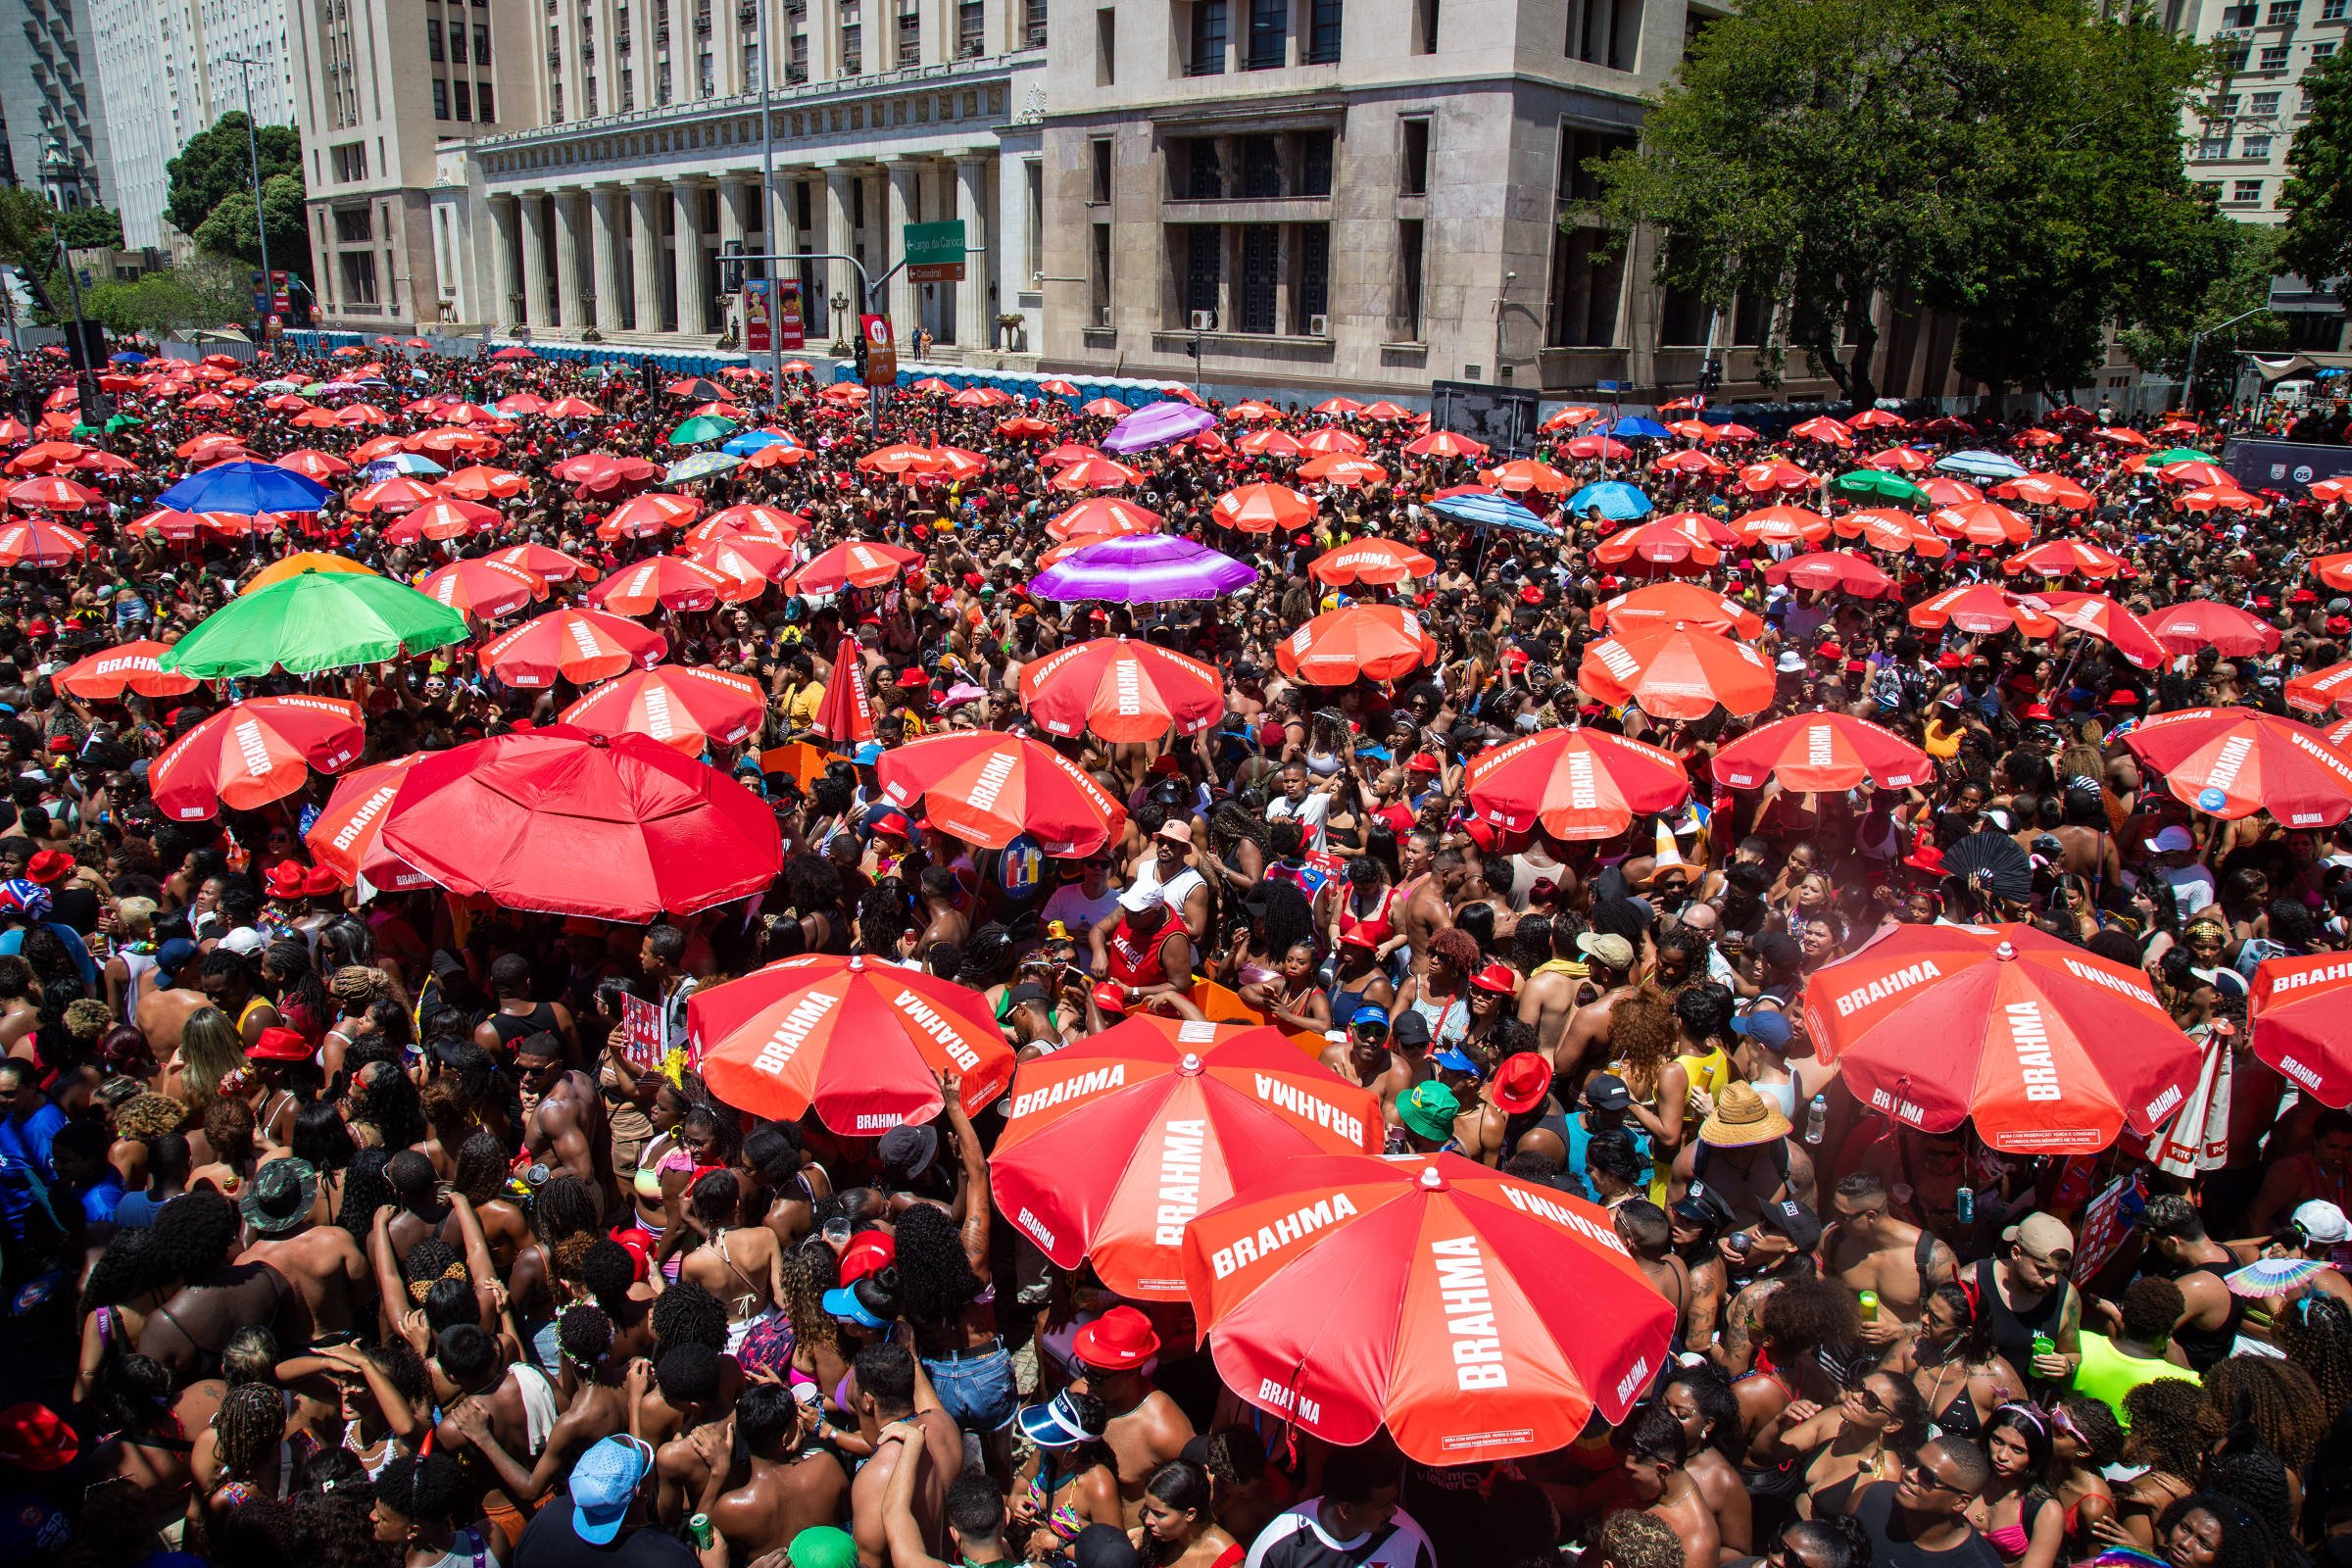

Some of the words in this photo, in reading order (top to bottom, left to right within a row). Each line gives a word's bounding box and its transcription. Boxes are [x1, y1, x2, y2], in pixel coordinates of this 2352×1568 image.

[941, 236, 964, 249] Carioca
[916, 268, 942, 278] Catedral
[890, 452, 932, 462] BRAHMA
[1744, 520, 1790, 533] BRAHMA
[1336, 552, 1391, 567] BRAHMA
[494, 602, 516, 615] BRAHMA
[568, 620, 601, 659] BRAHMA
[95, 656, 177, 675] BRAHM
[1033, 645, 1089, 688] BRAHMA
[1116, 659, 1141, 715] BRAHMA
[645, 686, 672, 739] BRAHMA
[727, 725, 749, 742] BRAHMA
[234, 718, 272, 777] BRAHMA
[1474, 739, 1538, 778] BRAHMA
[1809, 725, 1832, 765] BRAHMA
[2206, 735, 2254, 790] BRAHMA
[887, 781, 908, 801] BRAHMA
[966, 752, 1018, 812] BRAHMA
[1054, 755, 1112, 816] BRAHMA
[1568, 751, 1596, 809] BRAHMA
[180, 807, 205, 817] BRAHMA
[332, 786, 398, 852] BRAHMA
[1490, 810, 1515, 827] BRAMA
[2292, 812, 2324, 824] BRAHMA
[1044, 842, 1075, 854] BRAHMA
[1836, 960, 1941, 1017] BRAHMA
[2062, 957, 2163, 1010] BRAHMA
[753, 991, 839, 1074] BRAHMA
[894, 989, 980, 1072] BRAHMA
[2005, 1001, 2062, 1102] BRAHMA
[1012, 1063, 1125, 1119] BRAHMA
[2279, 1054, 2323, 1091] BRAHMA
[857, 1113, 904, 1130] BRAHMA
[1254, 1072, 1363, 1148] BRAHMA
[1872, 1088, 1925, 1126] BRMA
[2146, 1083, 2183, 1124] BRAHMA
[1155, 1119, 1205, 1246] BRAHMA
[1018, 1206, 1055, 1252] BRAHMA
[1211, 1193, 1358, 1280] BRAHMA
[1499, 1184, 1633, 1259] BRAHMA
[1431, 1235, 1508, 1392] BRAHMA
[1617, 1355, 1648, 1406] BRAHMA
